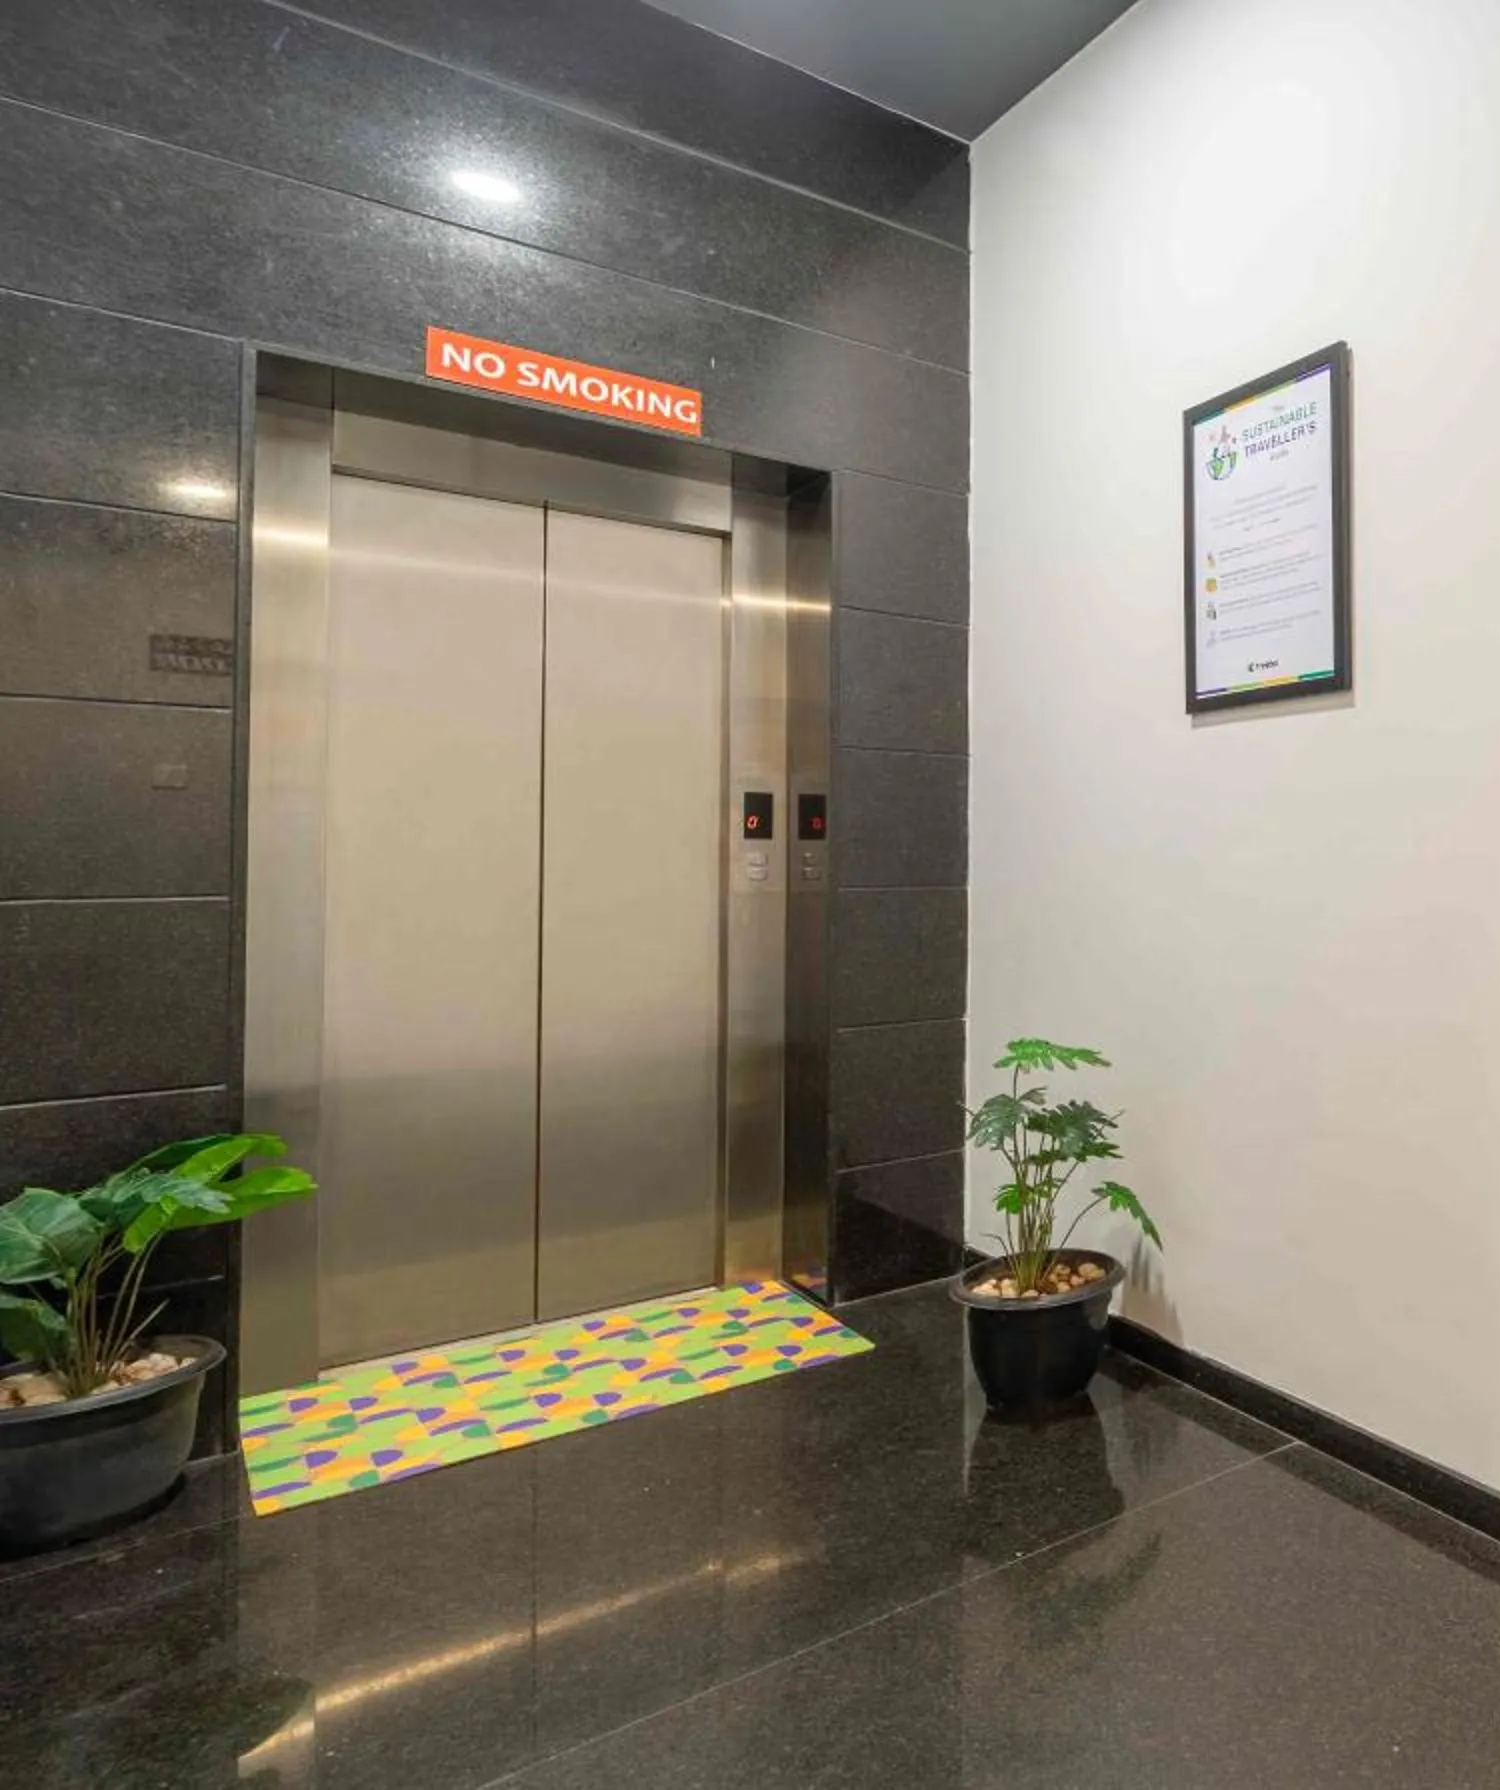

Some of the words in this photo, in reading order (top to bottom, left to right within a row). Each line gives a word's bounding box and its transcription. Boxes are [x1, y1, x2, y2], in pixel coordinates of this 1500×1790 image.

[441, 342, 506, 378] NO
[516, 361, 697, 424] SMOKING
[1241, 401, 1318, 442] SUSTAINABLE
[1244, 419, 1318, 458] TRAVELLER'S
